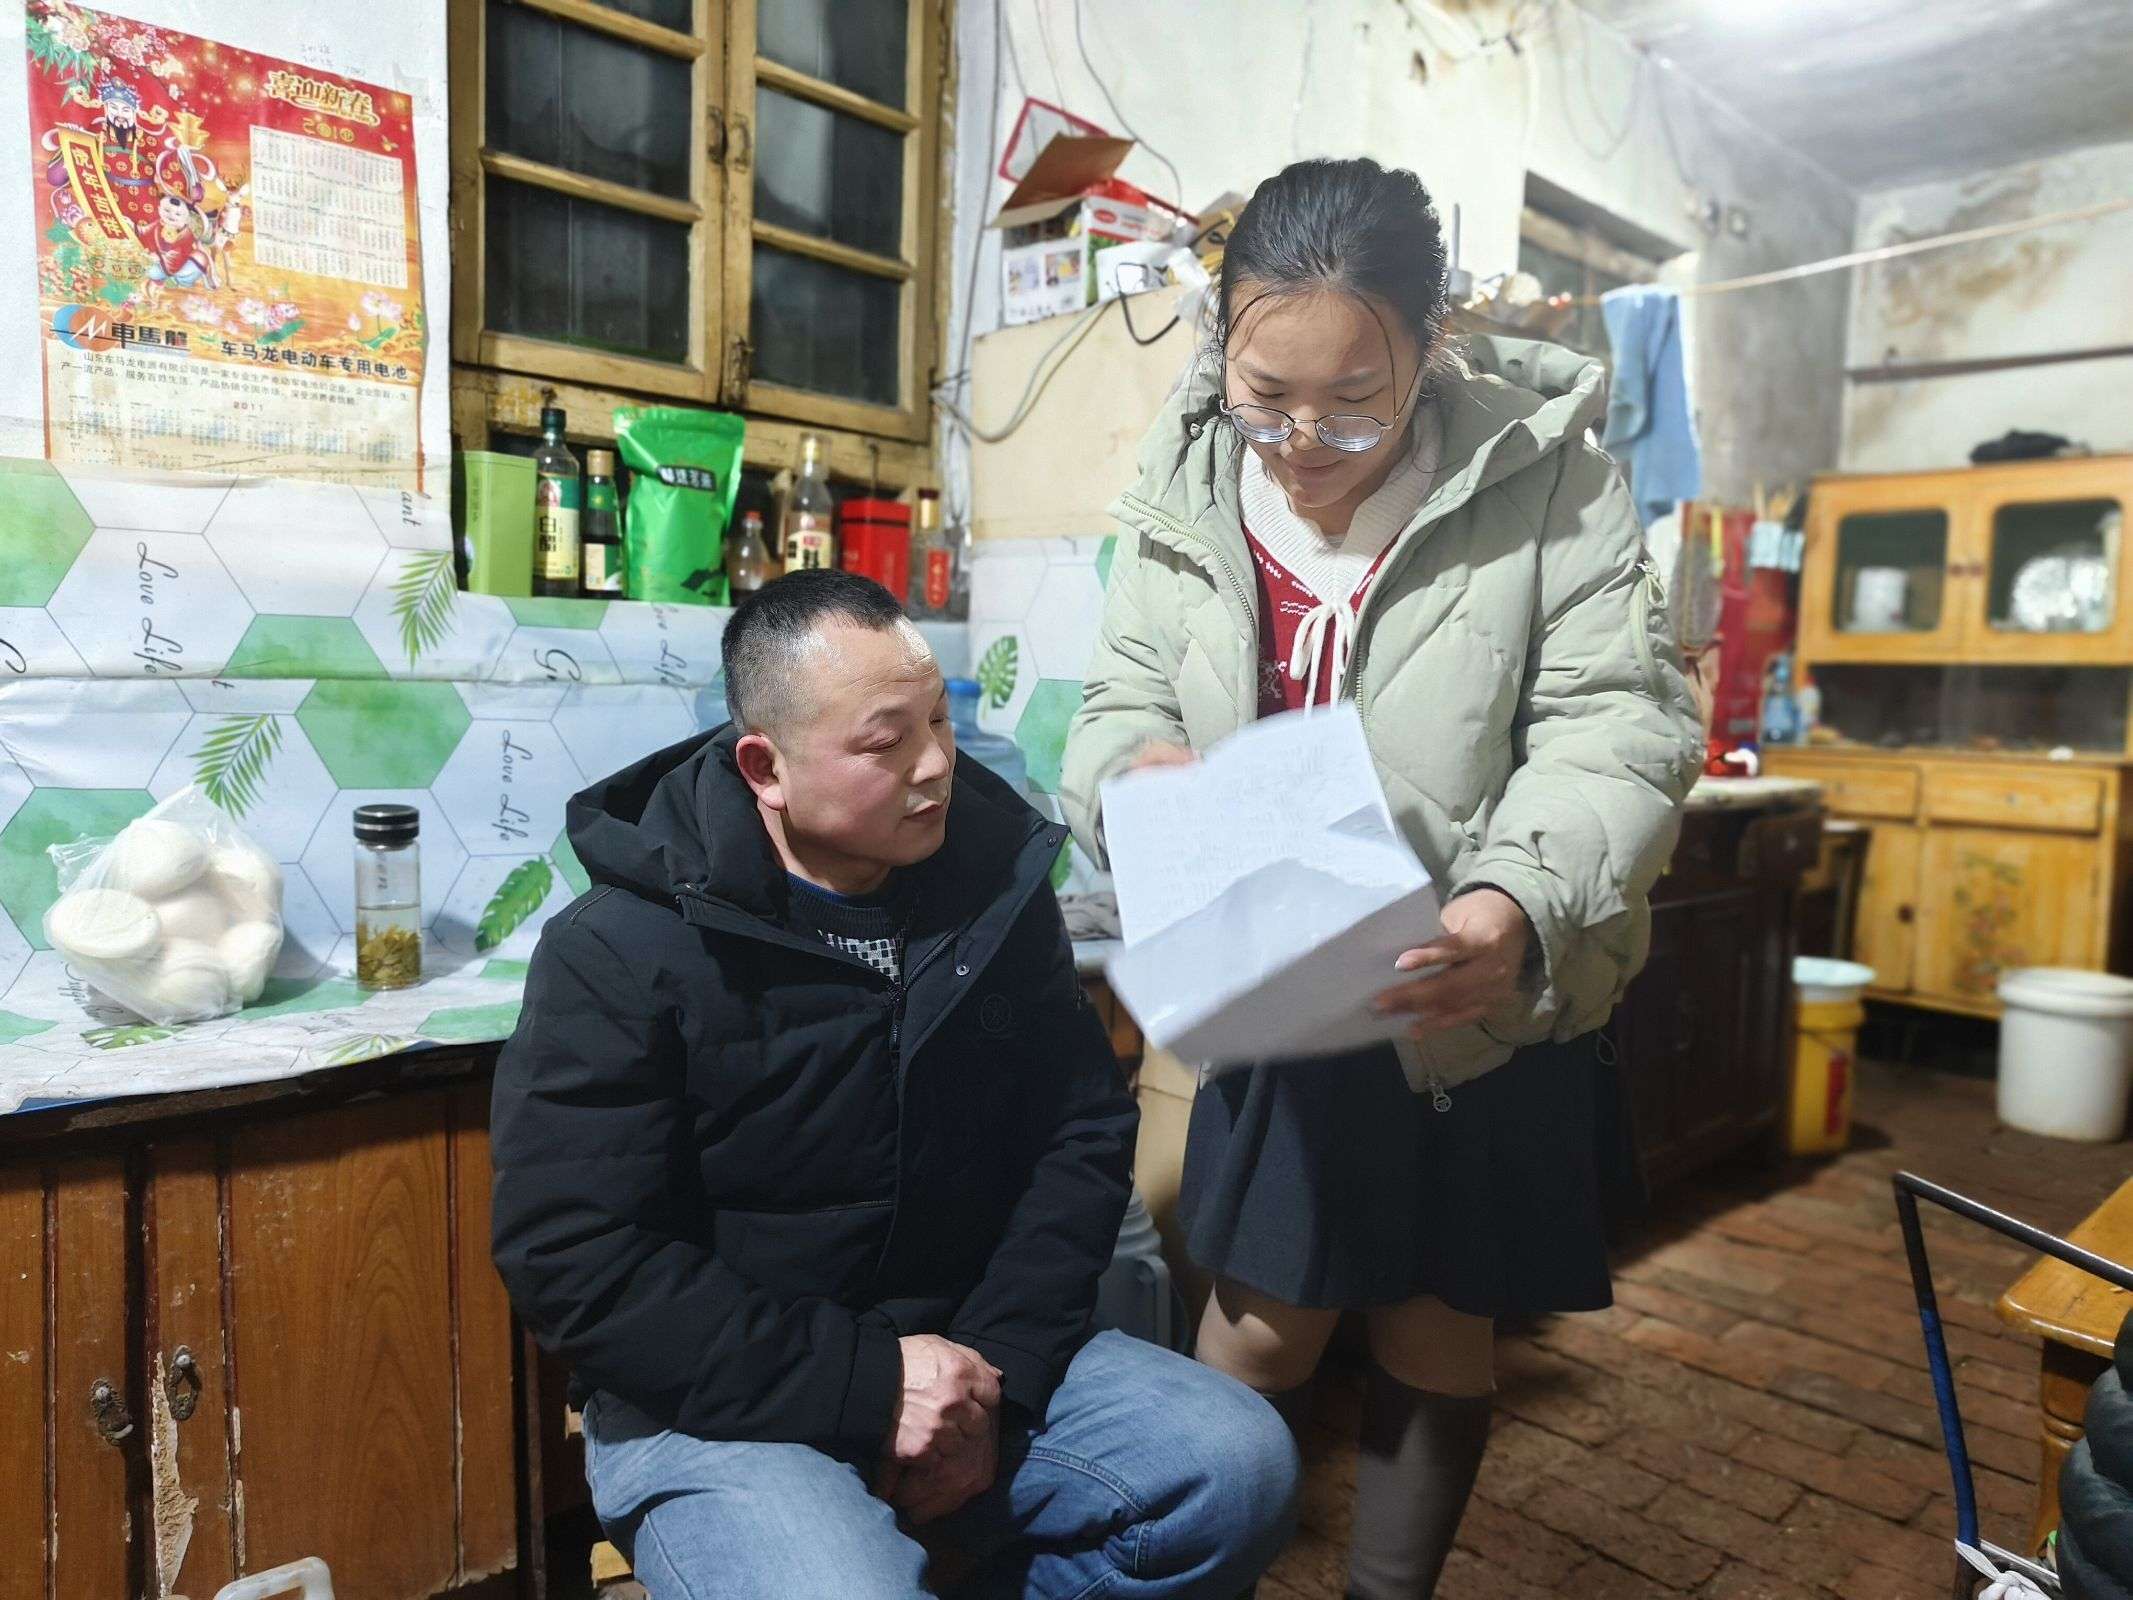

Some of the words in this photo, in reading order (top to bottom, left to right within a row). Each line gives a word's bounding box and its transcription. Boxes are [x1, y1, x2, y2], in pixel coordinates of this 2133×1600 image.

[265, 70, 376, 119] 喜迎新春
[302, 116, 355, 142] 2010
[70, 144, 124, 238] 虎年吉祥
[220, 340, 409, 380] 车马龙电动车专用电池
[233, 401, 264, 412] 2011
[137, 541, 179, 605] Love
[133, 617, 183, 674] Life
[502, 729, 533, 783] Love
[491, 793, 530, 841] Life
